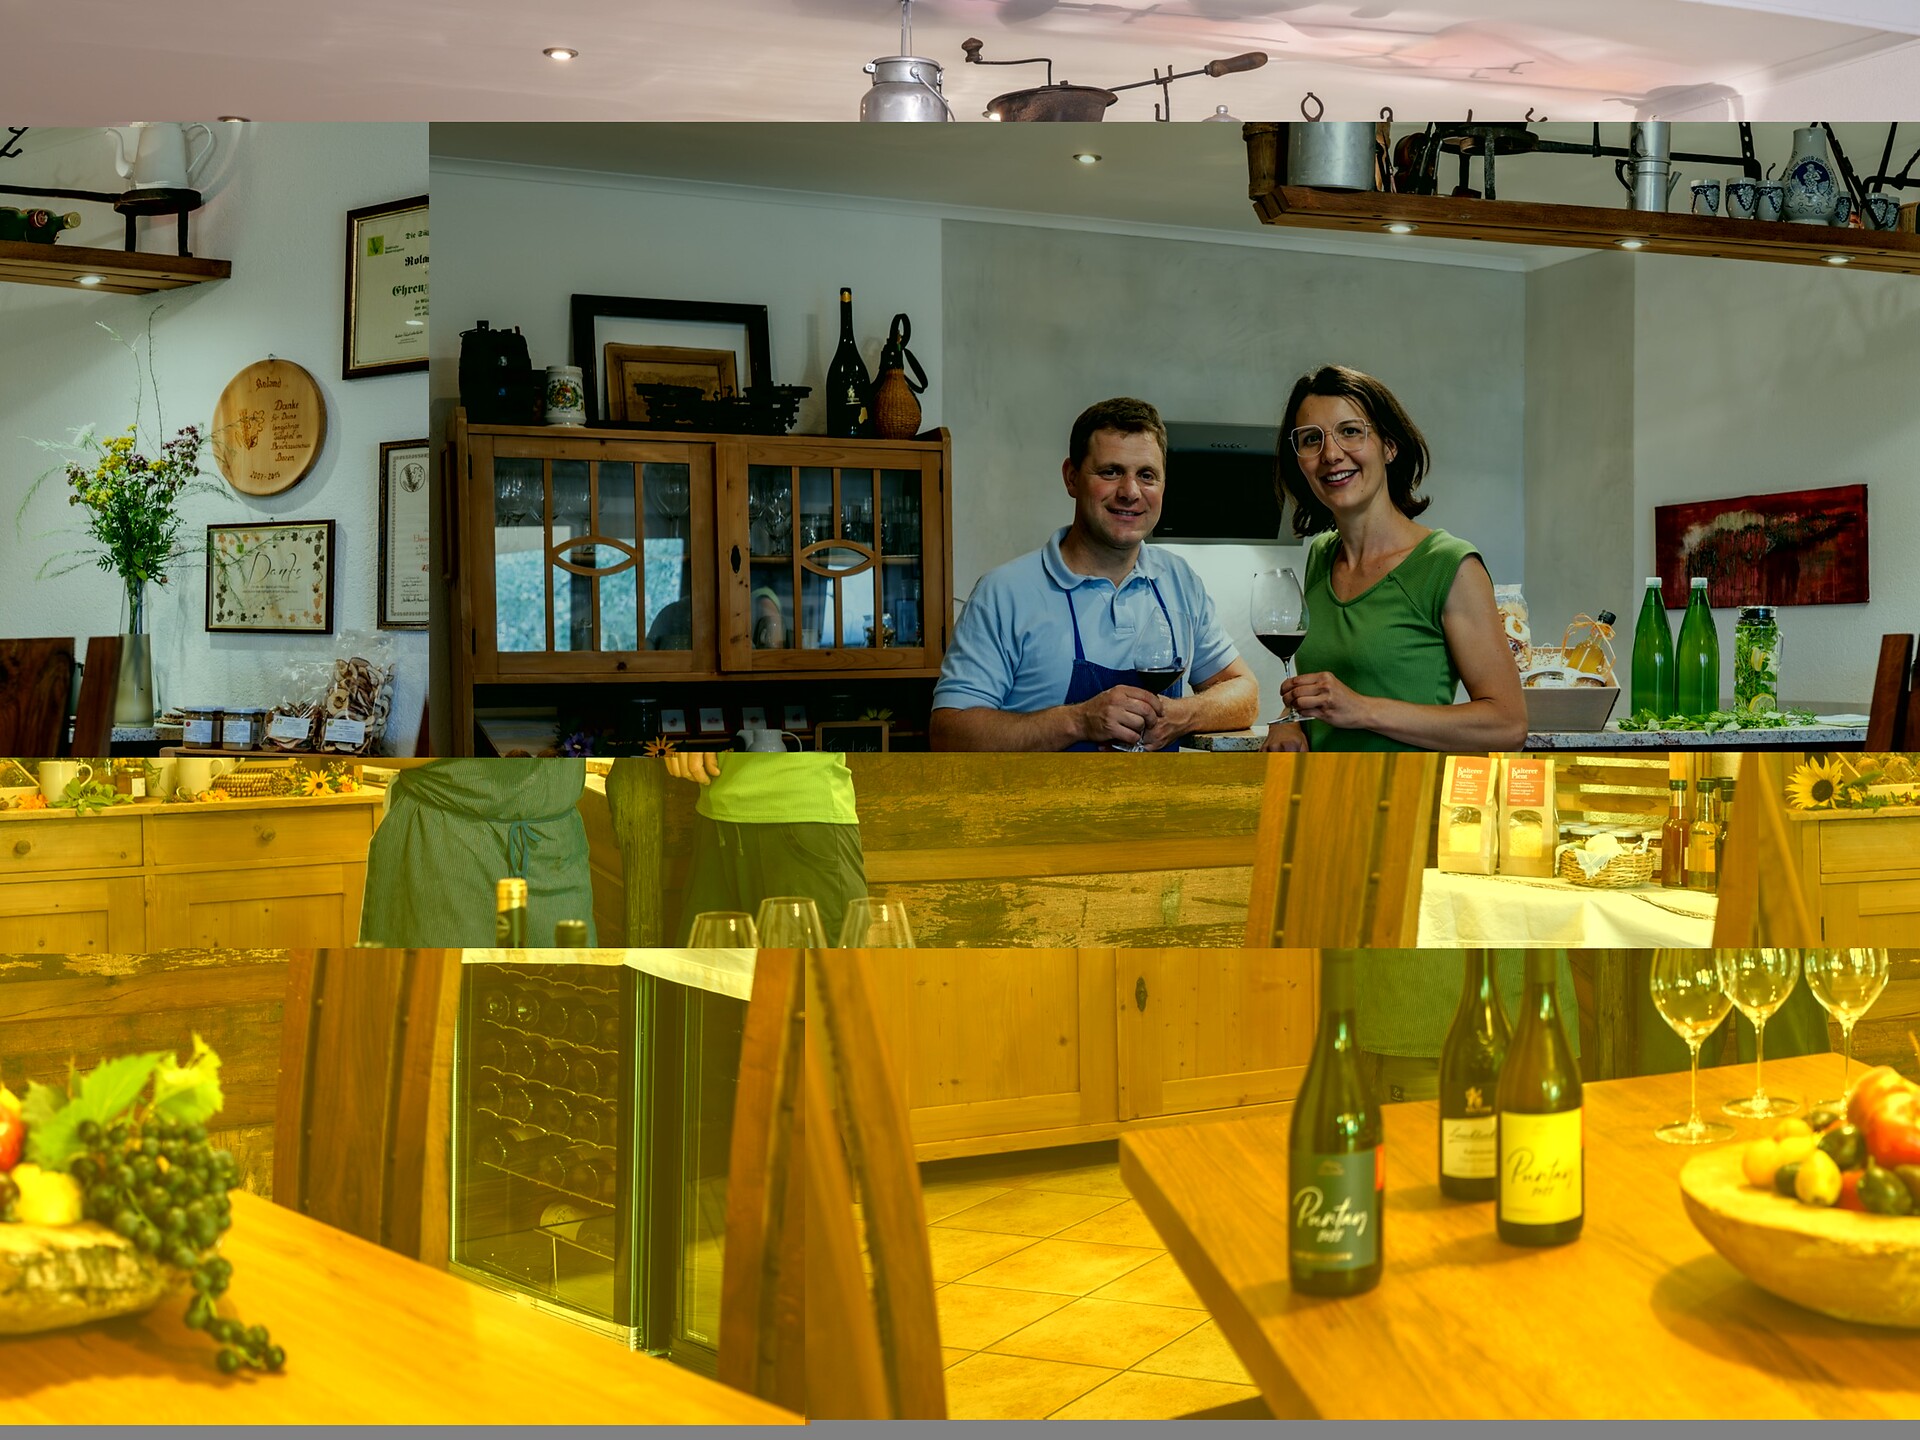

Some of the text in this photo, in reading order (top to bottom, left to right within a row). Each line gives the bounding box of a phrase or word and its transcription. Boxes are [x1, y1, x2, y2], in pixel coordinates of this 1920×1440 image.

[256, 377, 281, 391] Roland
[274, 400, 299, 410] Danke
[248, 551, 302, 583] Danke
[1457, 766, 1484, 774] Kalterer
